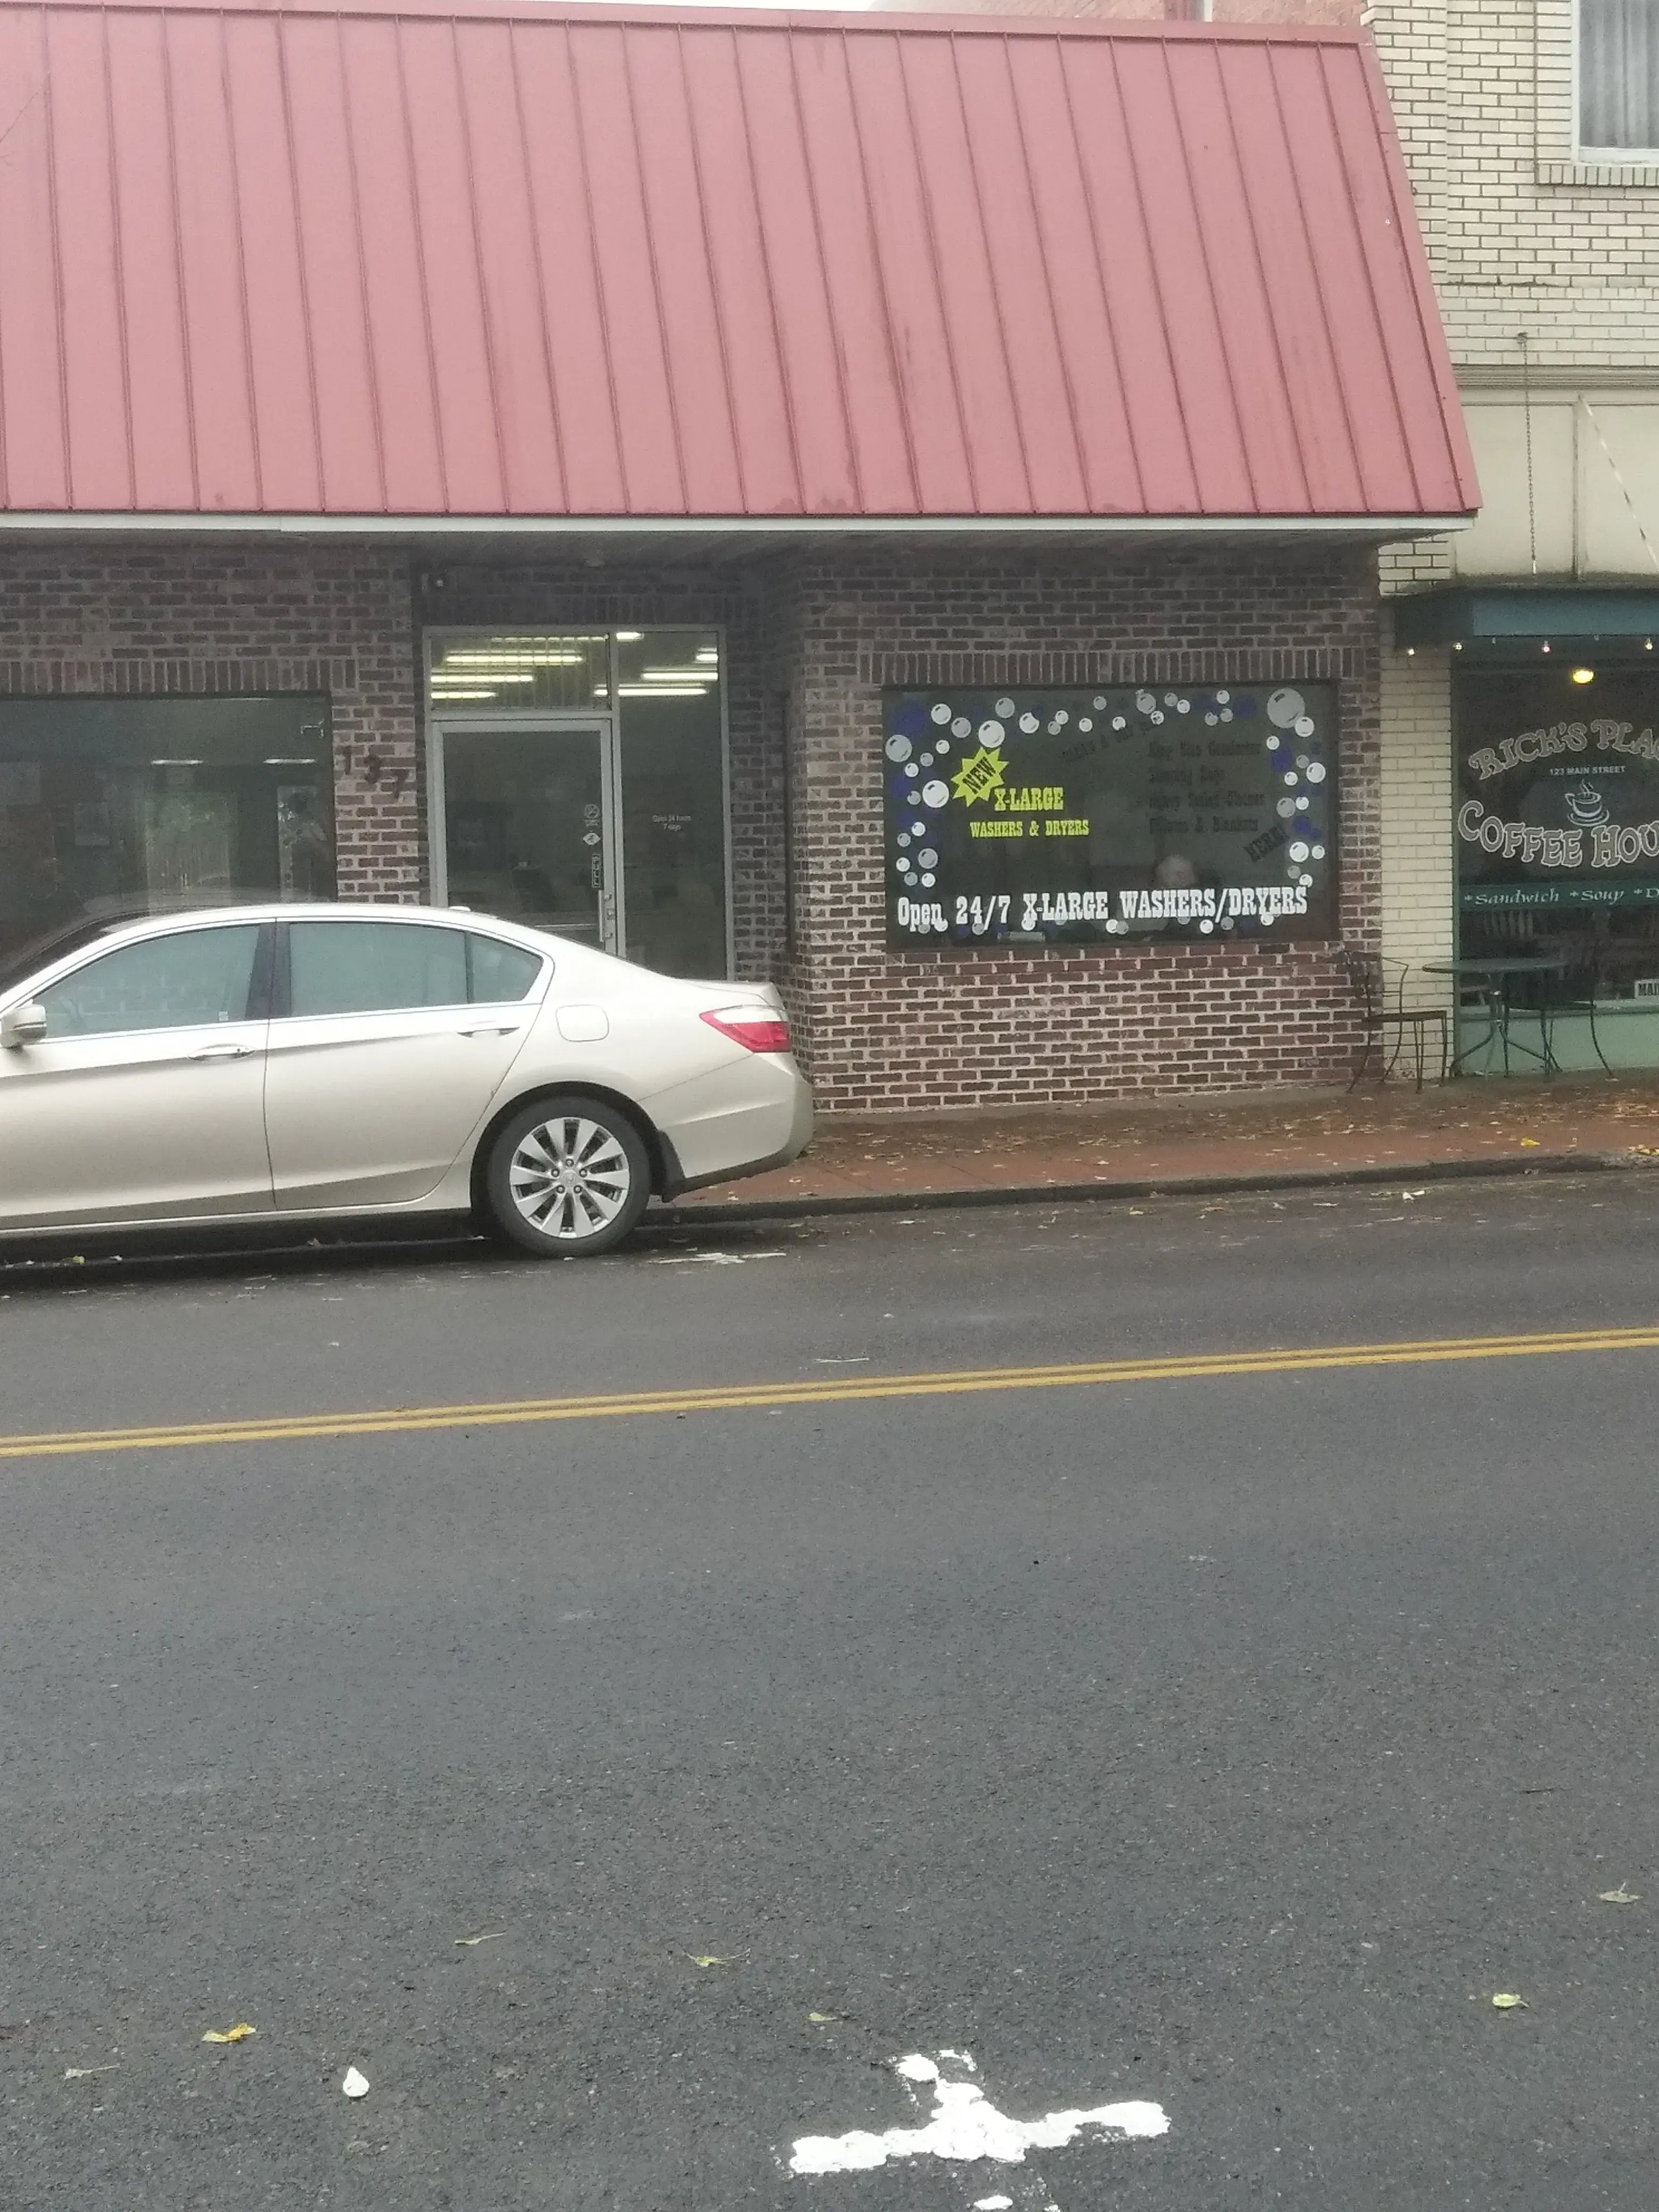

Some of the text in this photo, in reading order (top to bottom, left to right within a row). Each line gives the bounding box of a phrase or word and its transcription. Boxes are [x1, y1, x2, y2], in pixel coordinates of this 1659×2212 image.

[1468, 722, 1587, 780] RICK'S
[962, 757, 996, 795] NEW
[1567, 766, 1589, 775] MAIN
[1592, 765, 1626, 774] STREET
[994, 787, 1064, 811] X-LARGE
[969, 819, 1090, 838] WASHERS & DRYERS
[1458, 800, 1583, 868] COFFEE
[898, 886, 1308, 932] Open 24/7 X-LARGE WASHERS/DRYERS
[1475, 888, 1560, 904] Sandwich
[1580, 890, 1624, 904] Soup
